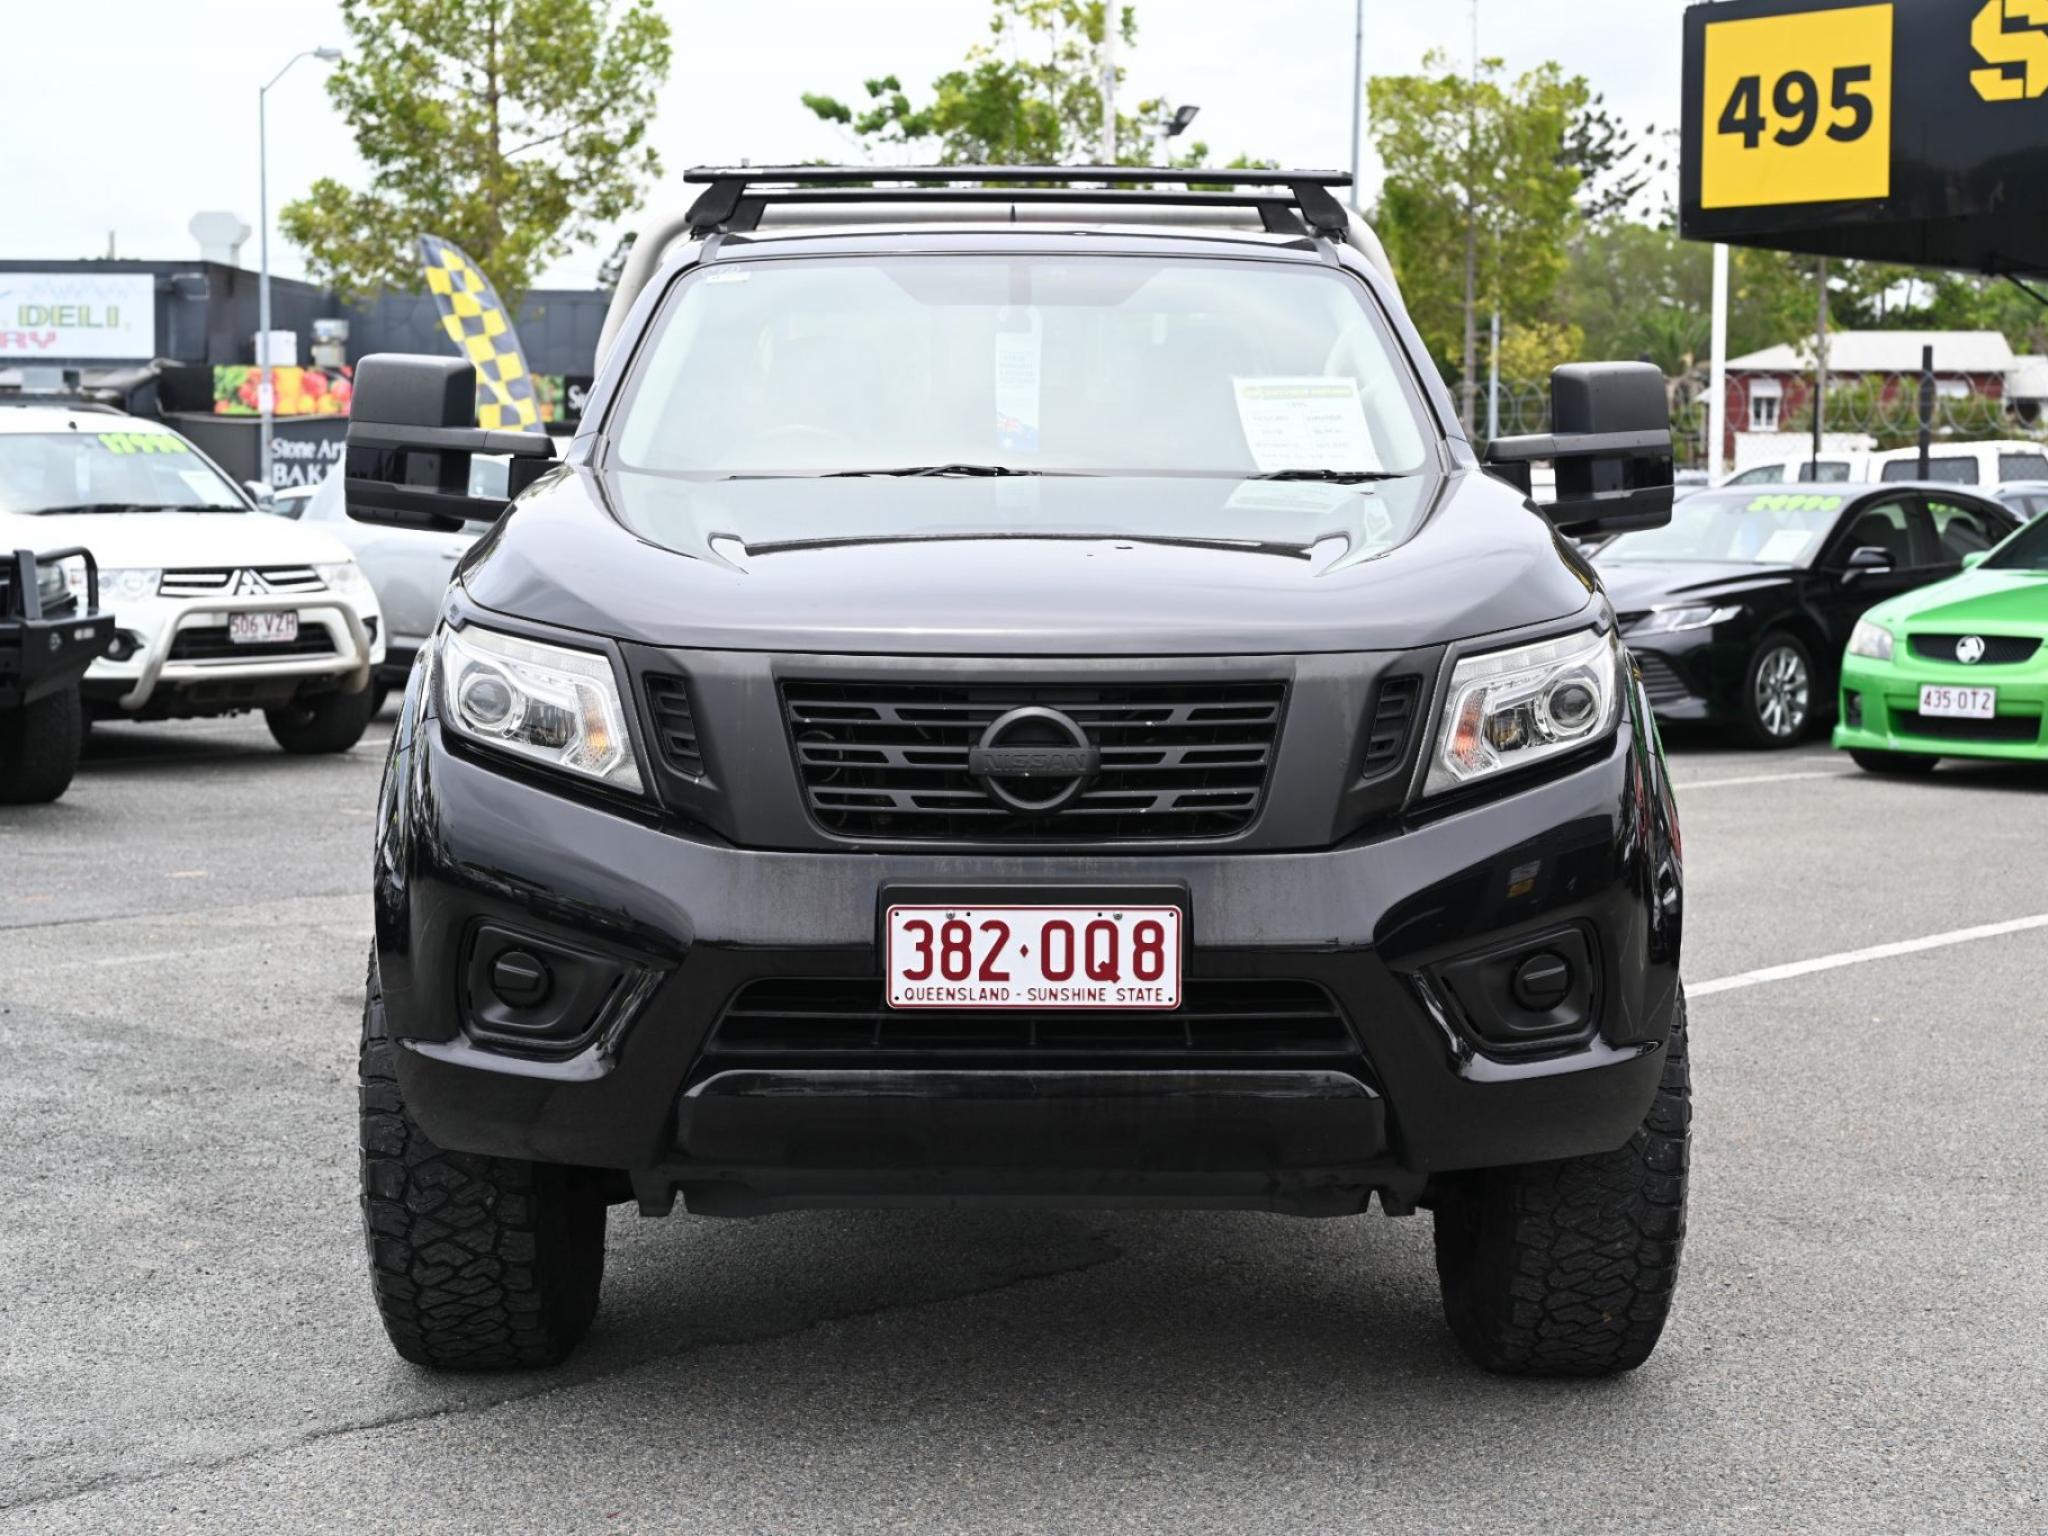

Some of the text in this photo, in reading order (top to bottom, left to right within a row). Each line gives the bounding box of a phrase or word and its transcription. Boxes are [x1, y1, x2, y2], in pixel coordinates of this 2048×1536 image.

[1718, 64, 1873, 149] 495
[272, 437, 317, 460] Stone
[272, 462, 331, 487] BAK
[230, 613, 258, 633] 506
[983, 753, 1087, 772] NISSAN
[904, 987, 1010, 1001] QUEENSLAND
[1027, 987, 1107, 1001] SUNSHINE
[1116, 987, 1164, 1001] STATE
